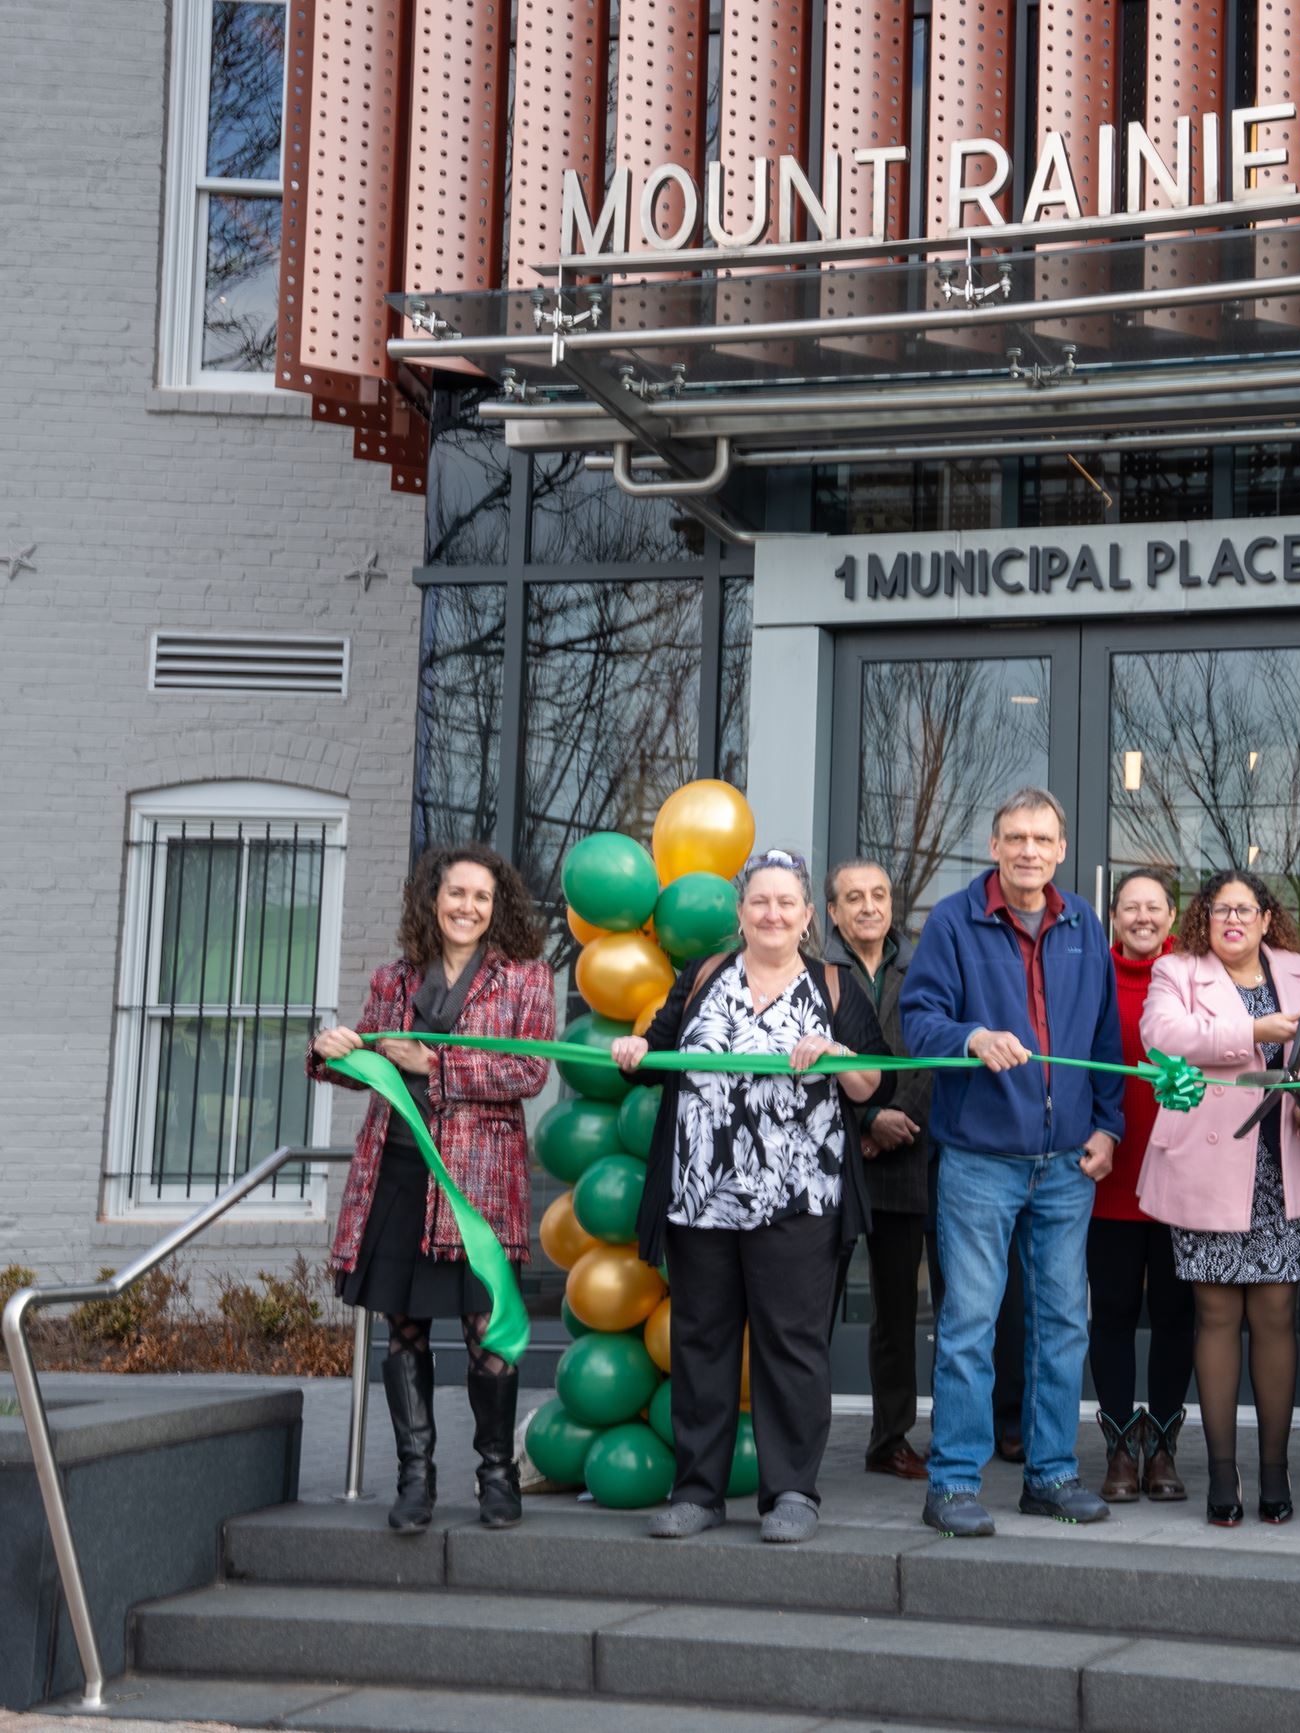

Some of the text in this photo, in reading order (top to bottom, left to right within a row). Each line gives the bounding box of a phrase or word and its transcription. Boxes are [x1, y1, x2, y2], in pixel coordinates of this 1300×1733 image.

[561, 146, 909, 256] MOUNT
[834, 554, 856, 600] 1
[867, 542, 1132, 599] MUNICIPAL
